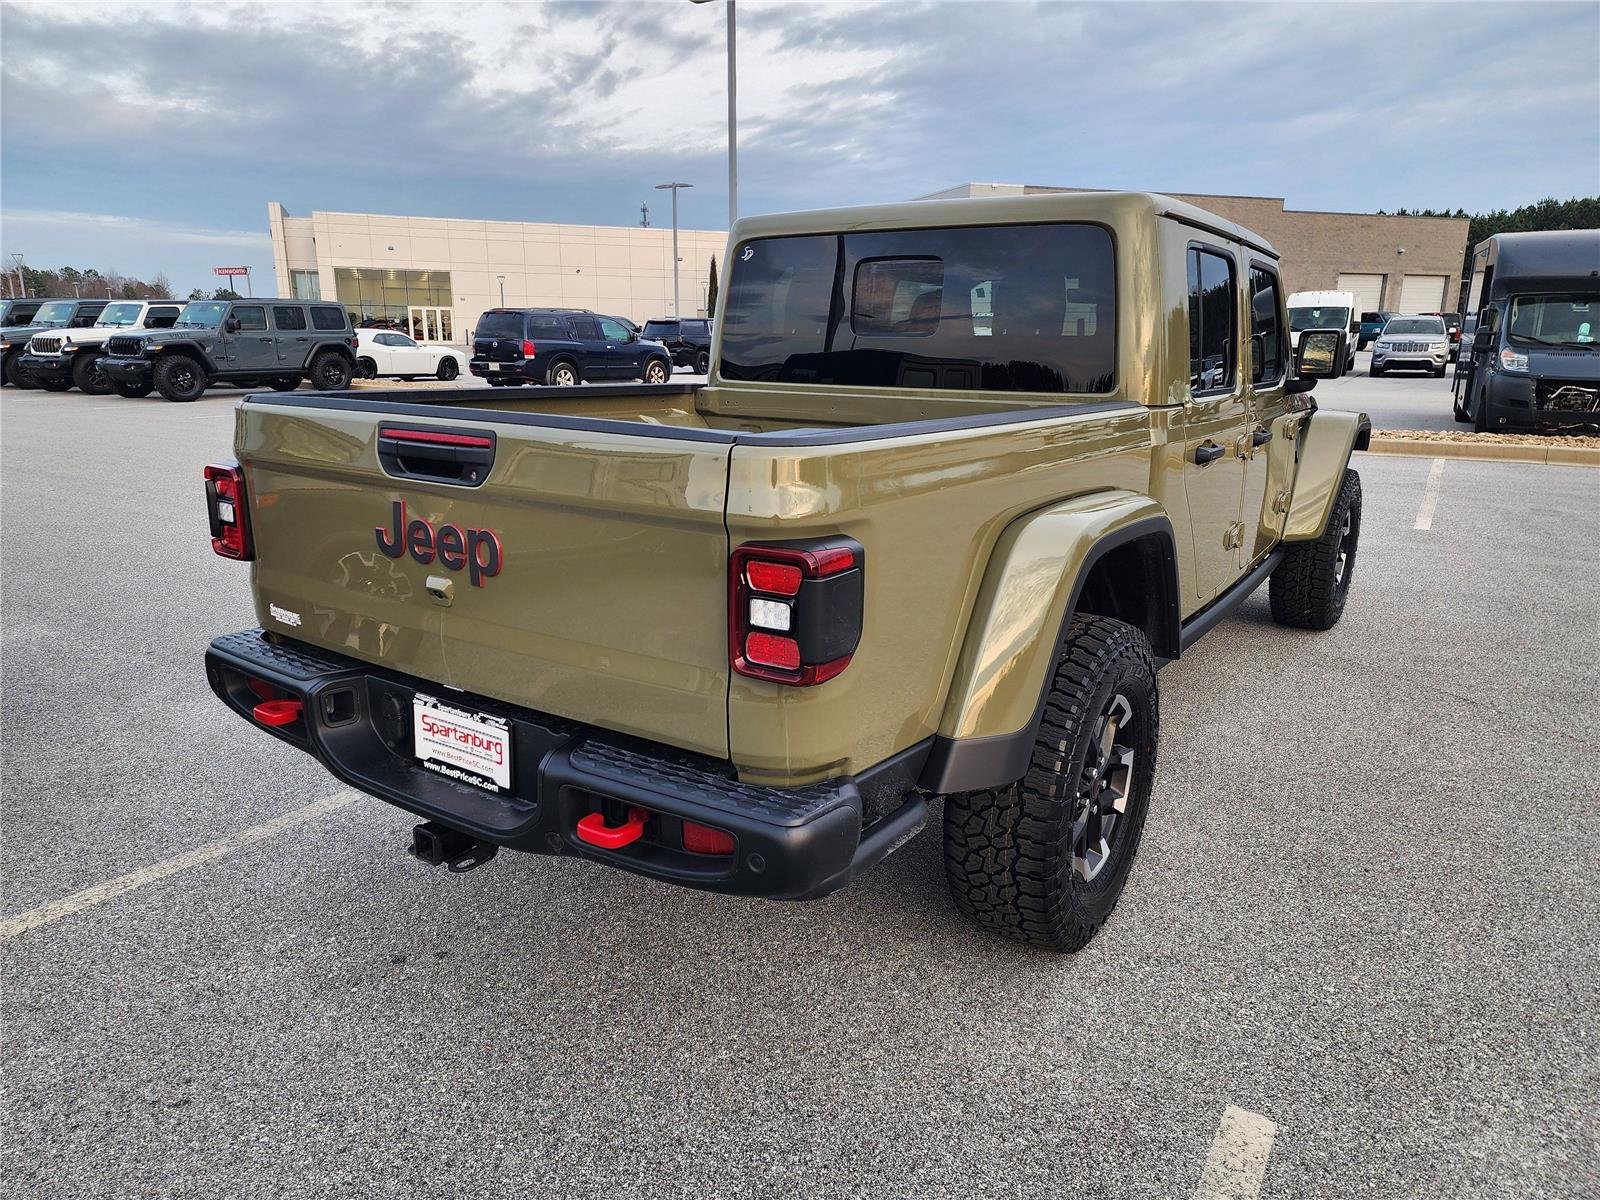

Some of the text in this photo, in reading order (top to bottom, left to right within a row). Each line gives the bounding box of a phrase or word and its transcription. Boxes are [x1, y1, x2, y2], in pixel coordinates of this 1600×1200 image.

[375, 498, 503, 588] Jeep
[421, 714, 502, 765] Spartanburg
[423, 761, 499, 793] www.BestPriceSC.com
[431, 748, 494, 773] www.BestPriceSC.com
